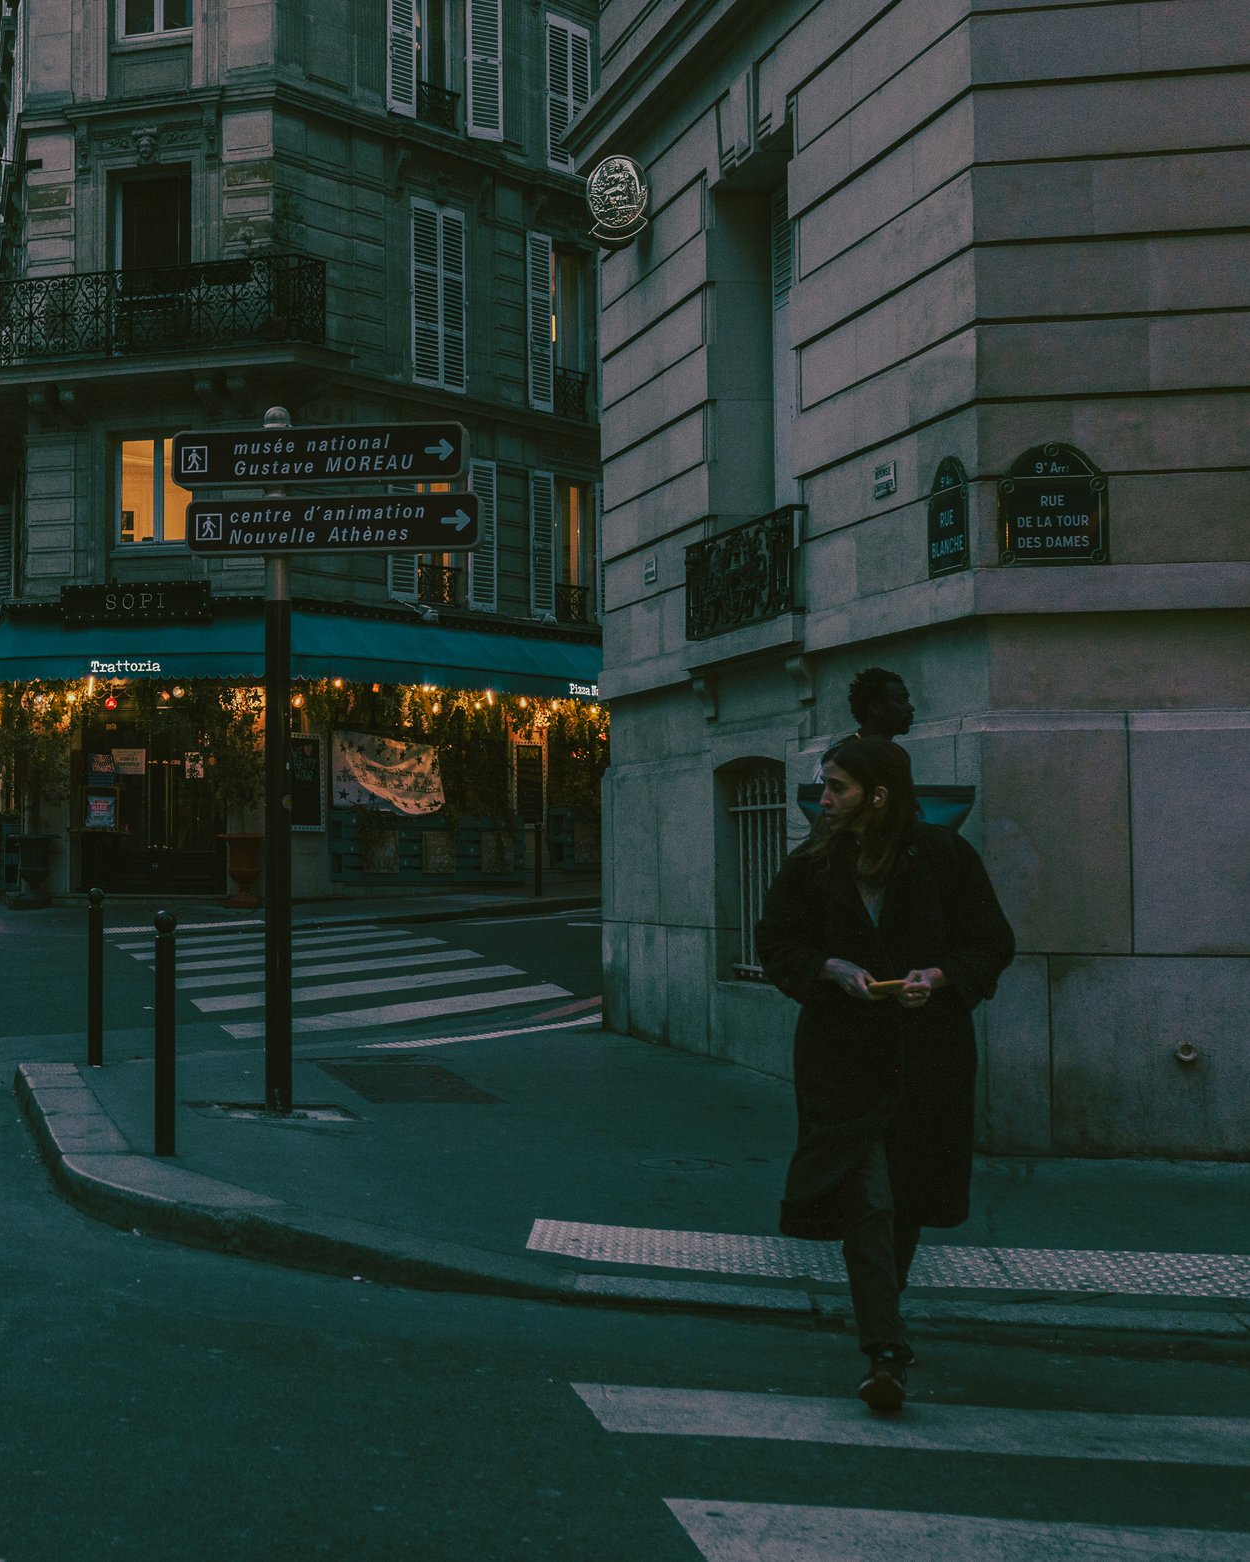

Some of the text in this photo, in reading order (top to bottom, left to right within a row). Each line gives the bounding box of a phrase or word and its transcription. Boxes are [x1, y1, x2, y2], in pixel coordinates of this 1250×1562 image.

[234, 434, 390, 456] musée national
[234, 454, 414, 476] Gustave MOREAU
[1040, 495, 1065, 507] RUE
[230, 503, 426, 524] centre d'animation
[940, 507, 954, 529] RUE
[1017, 514, 1090, 528] DE LA TOUR
[229, 525, 409, 545] Nouvelle Athènes
[1017, 535, 1090, 549] DES DAMES
[932, 533, 964, 560] BLANCHE
[105, 593, 166, 610] SOPI
[91, 660, 161, 673] Trattoria
[569, 683, 591, 696] Pizza
